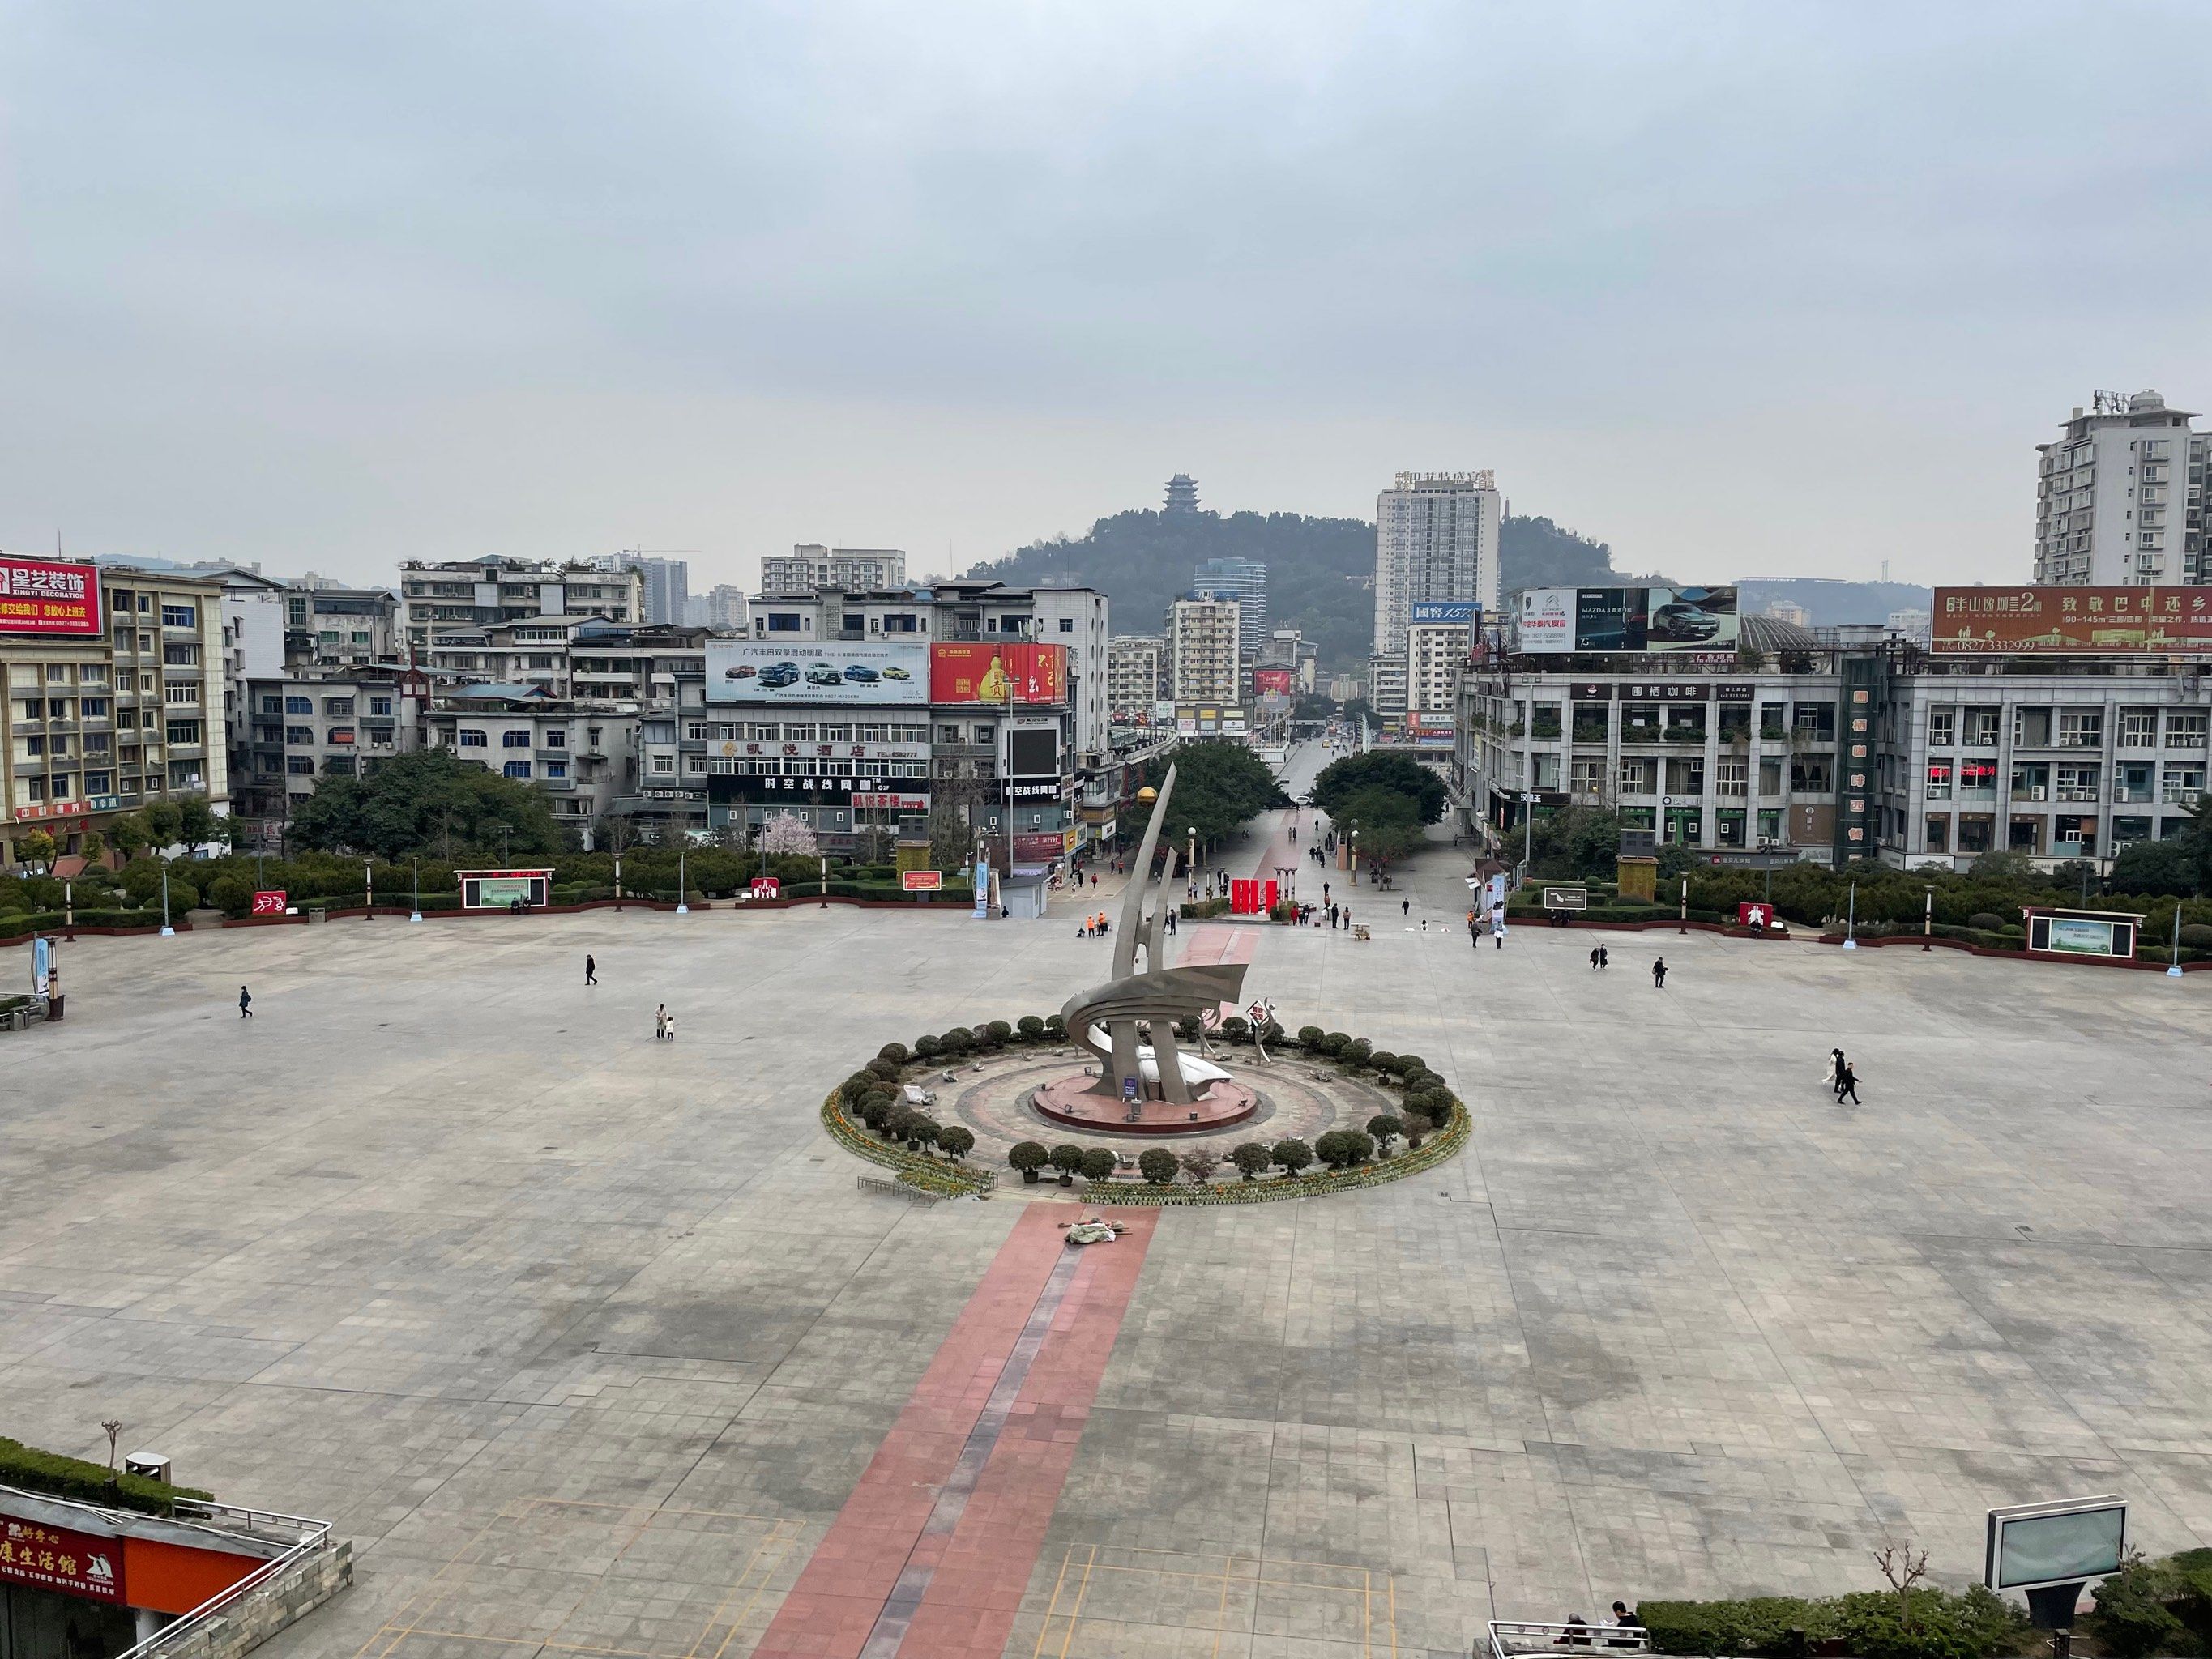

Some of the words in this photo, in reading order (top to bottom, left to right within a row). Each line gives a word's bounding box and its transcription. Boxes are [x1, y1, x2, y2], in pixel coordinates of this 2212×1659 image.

[12, 568, 84, 591] 星艺装饰
[41, 591, 85, 599] DECORATION
[2062, 596, 2206, 612] 致敬巴中还乡
[1958, 640, 1985, 651] 0827
[1988, 640, 2035, 651] 3332999
[742, 648, 822, 657] 广汽丰田双擎混动明星
[747, 744, 866, 757] 凯悦酒店
[1848, 691, 1868, 860] 栖咖啡西餐
[765, 778, 871, 790] 时空战线网咖
[853, 795, 900, 808] 凯悦茶楼
